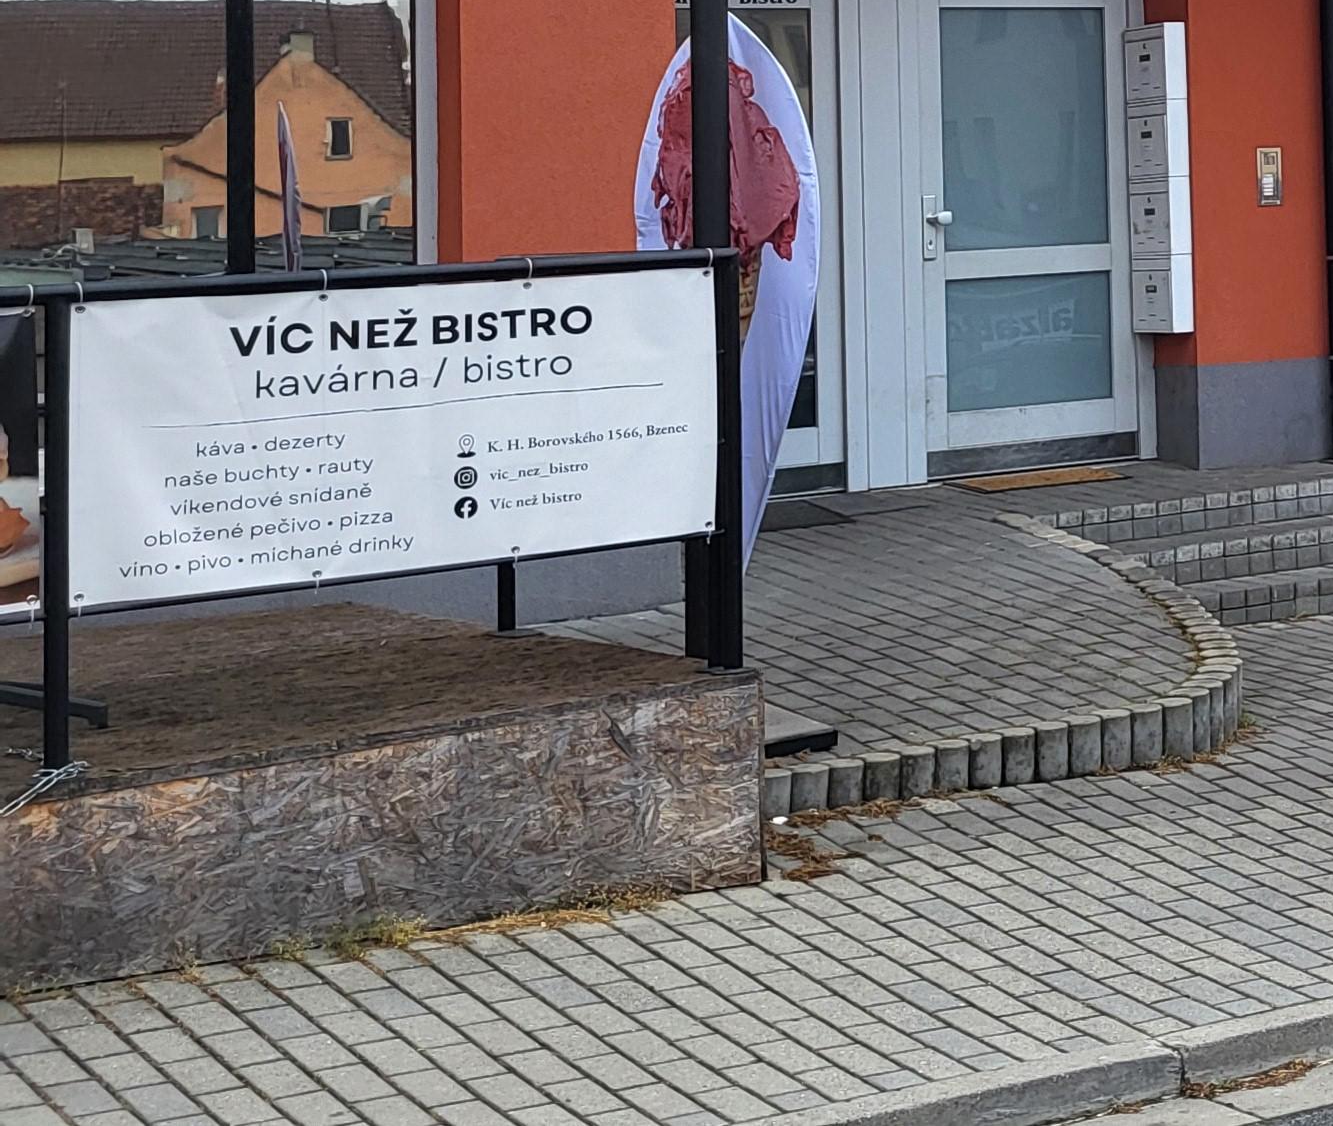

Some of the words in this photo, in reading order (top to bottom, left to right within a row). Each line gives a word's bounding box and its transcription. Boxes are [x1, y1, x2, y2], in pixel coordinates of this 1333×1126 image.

[229, 315, 314, 357] VÍC
[329, 308, 418, 351] NEŽ
[431, 305, 594, 345] BISTRO
[255, 363, 419, 399] kavárna
[463, 353, 573, 384] bistro
[195, 441, 246, 458] káva
[264, 432, 346, 453] dezerty
[487, 440, 503, 453] K.
[507, 438, 524, 451] H.
[528, 431, 604, 449] Borovského
[607, 426, 643, 442] 1566,
[646, 423, 689, 438] Bzenec
[164, 469, 218, 489] naše
[224, 462, 300, 484] buchty
[318, 457, 374, 476] rauty
[489, 460, 590, 482] vic_nez_bistro
[170, 491, 283, 516] víkendové
[288, 482, 373, 506] snídaně
[489, 497, 513, 511] Víc
[516, 493, 538, 508] než
[542, 491, 583, 505] bistro
[143, 523, 244, 548] obložené
[250, 516, 321, 541] pečivo
[339, 510, 394, 531] pizza
[119, 560, 168, 579] víno
[187, 554, 232, 575] pivo
[250, 540, 343, 565] míchané
[348, 534, 415, 555] drinky
